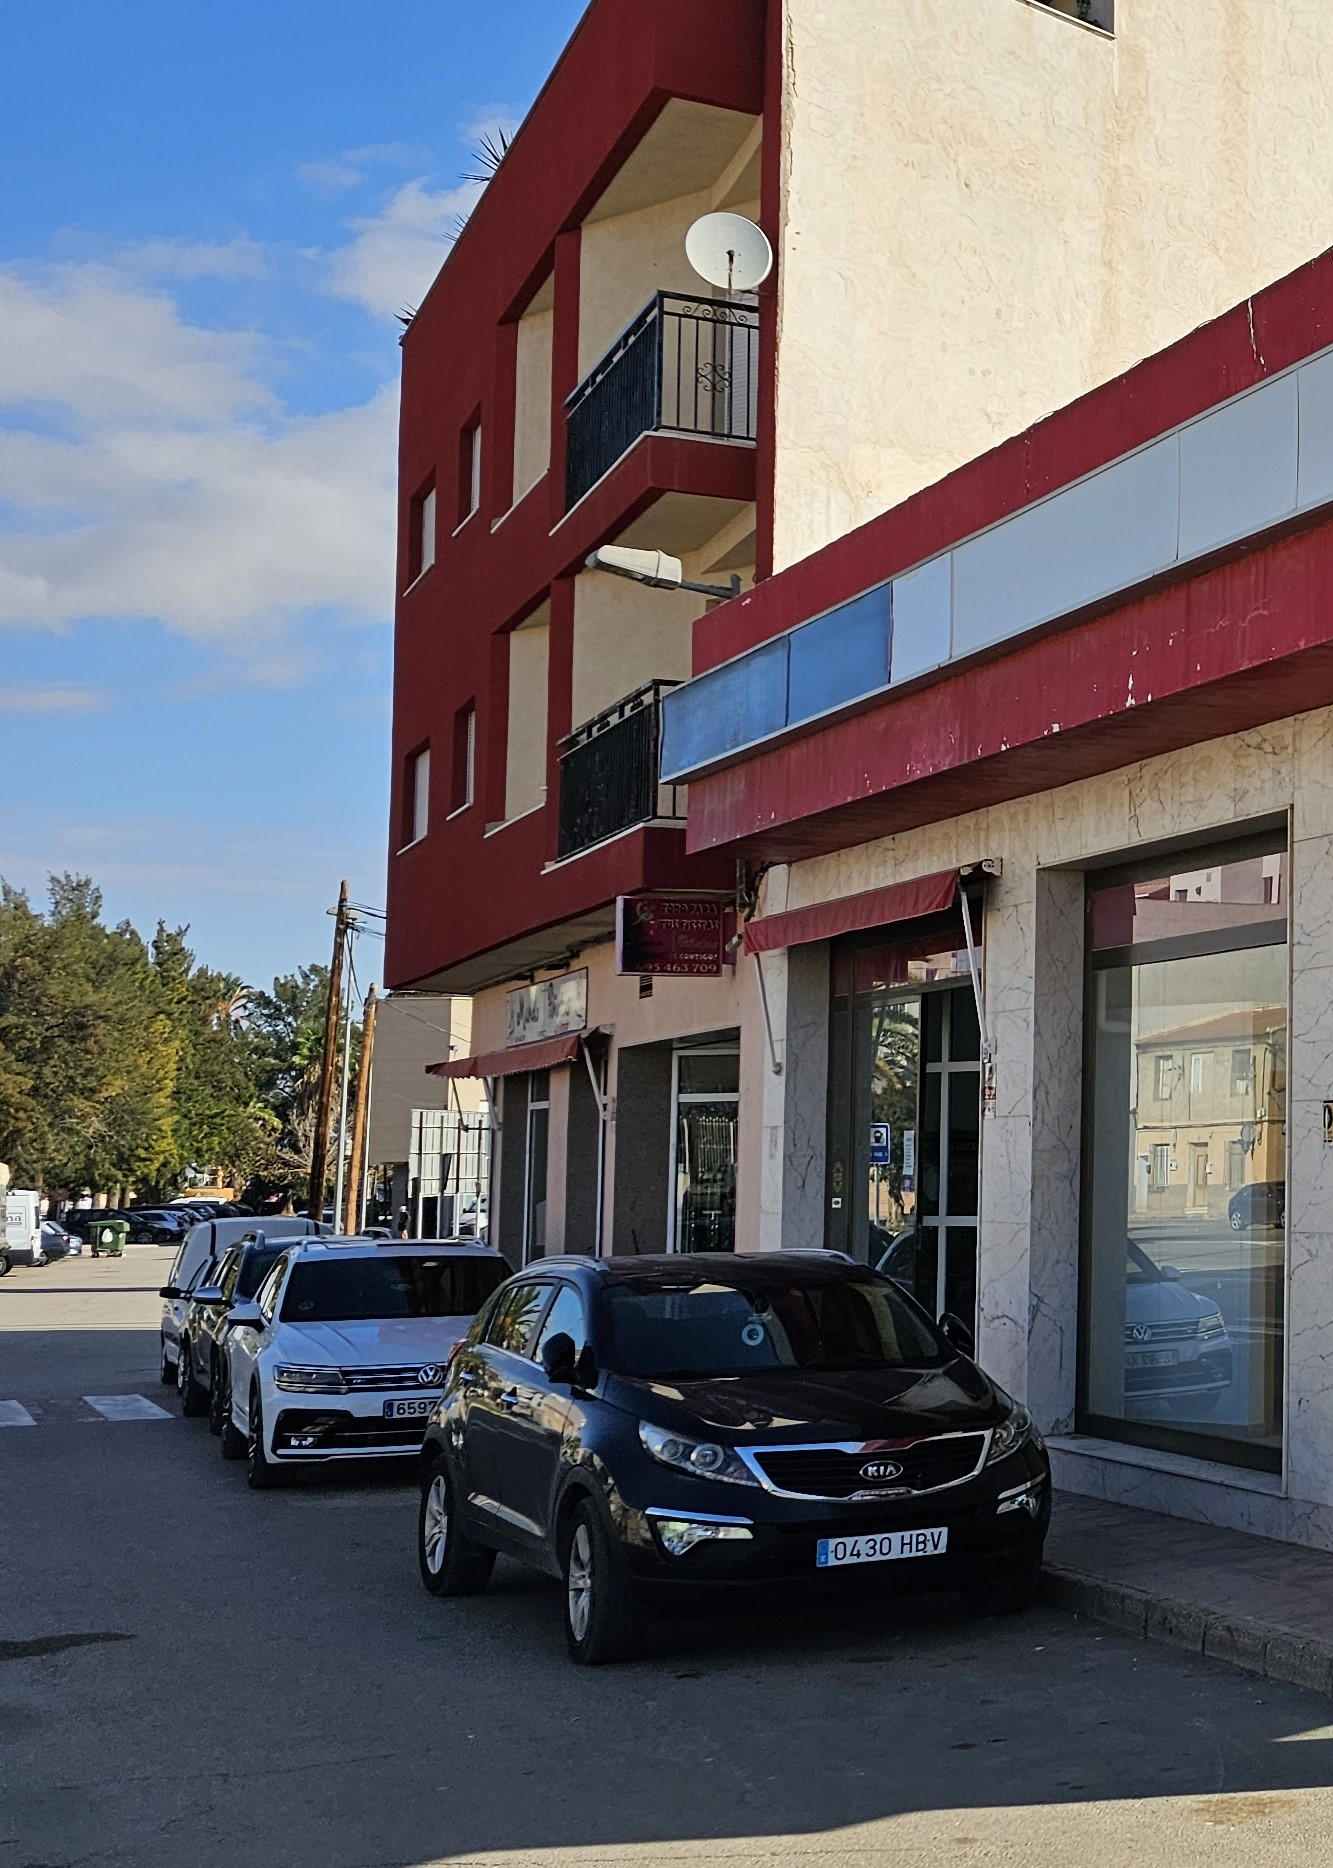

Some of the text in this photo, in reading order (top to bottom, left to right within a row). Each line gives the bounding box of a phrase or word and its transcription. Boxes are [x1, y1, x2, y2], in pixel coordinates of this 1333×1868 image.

[662, 903, 718, 914] TODO PARA
[661, 920, 719, 931] TUS FIESTAS
[664, 963, 689, 973] 463
[692, 963, 717, 973] 709
[396, 1401, 438, 1416] 6597
[867, 1464, 897, 1477] KIA
[834, 1531, 943, 1561] 0430 HBV
